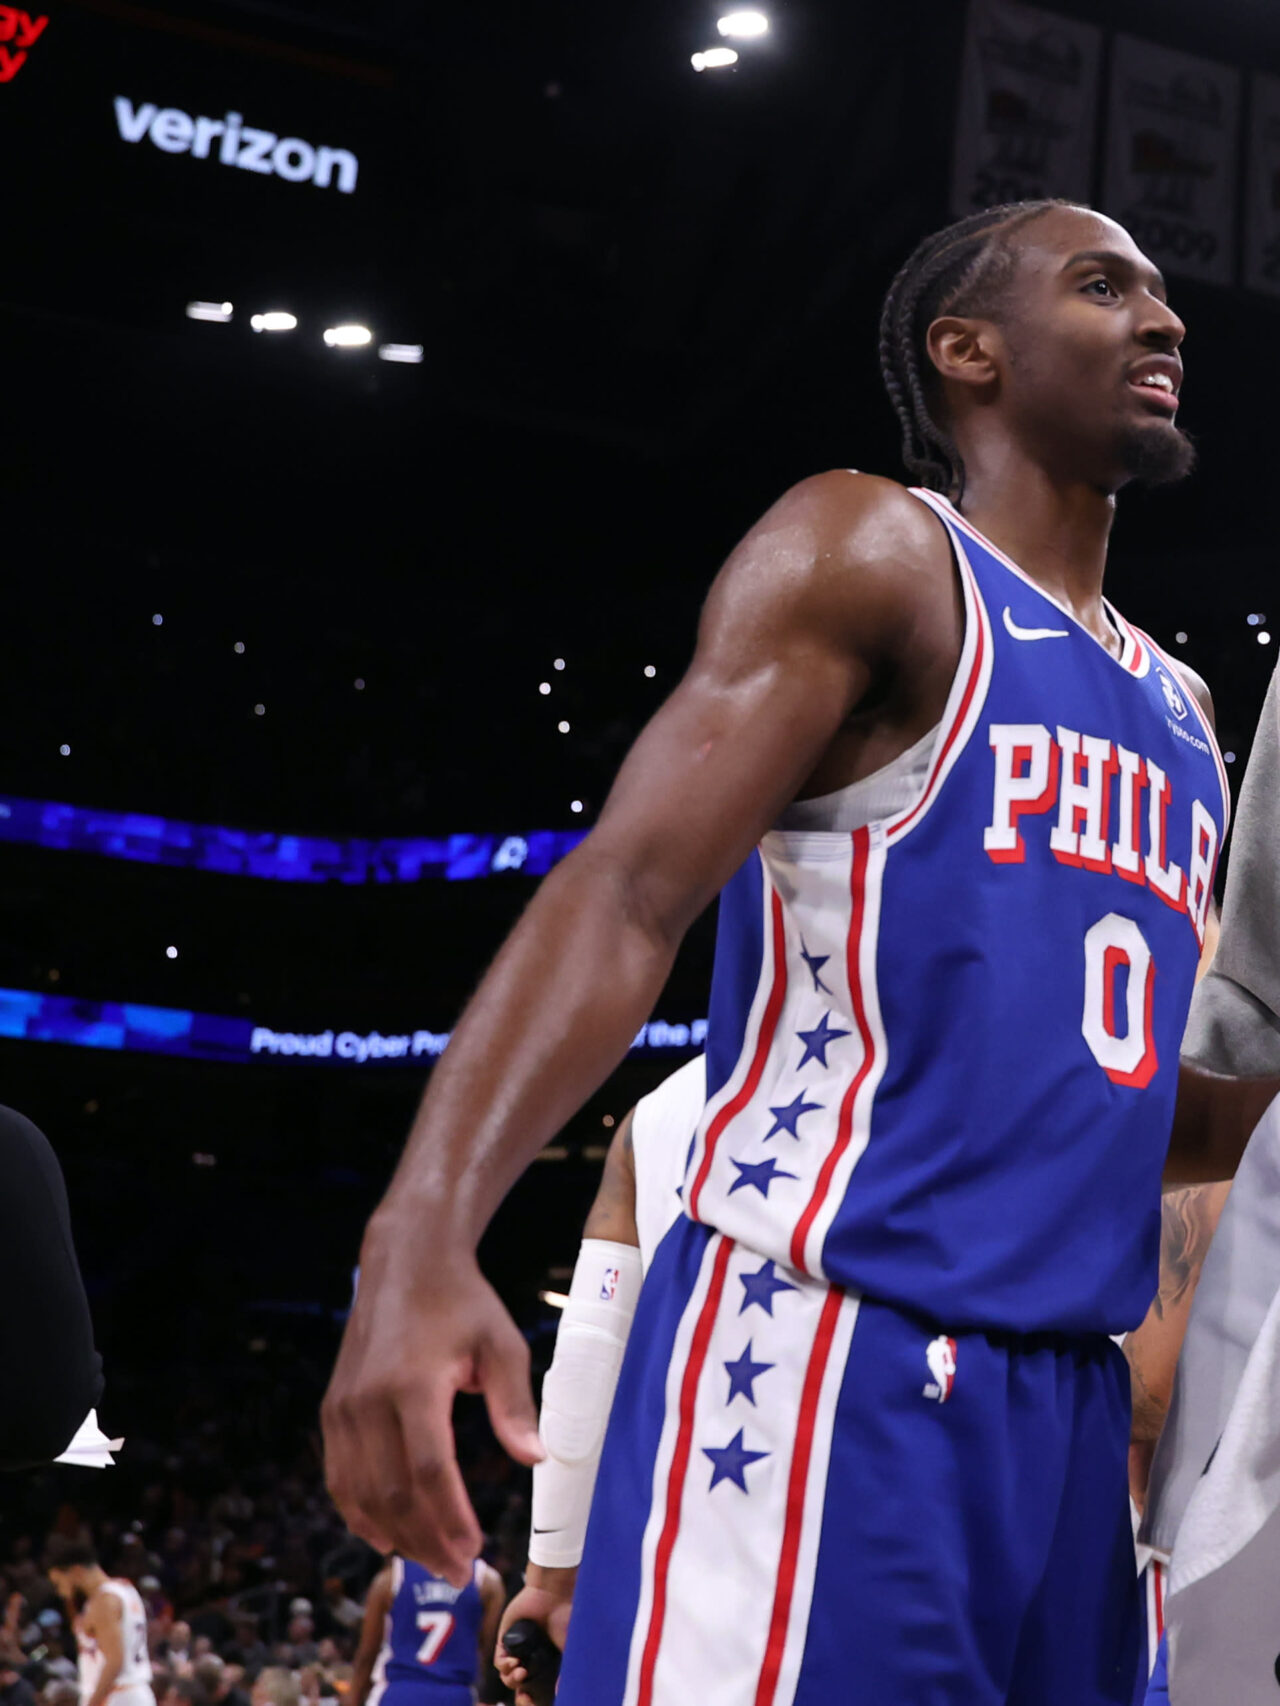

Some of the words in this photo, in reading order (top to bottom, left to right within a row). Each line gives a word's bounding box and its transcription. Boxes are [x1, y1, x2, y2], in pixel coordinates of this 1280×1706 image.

[113, 95, 359, 194] verizon
[983, 723, 1219, 950] PHILA
[251, 1027, 334, 1057] Proud
[335, 1031, 411, 1063] Cyber
[1081, 912, 1159, 1089] 0
[415, 1610, 456, 1665] 7
